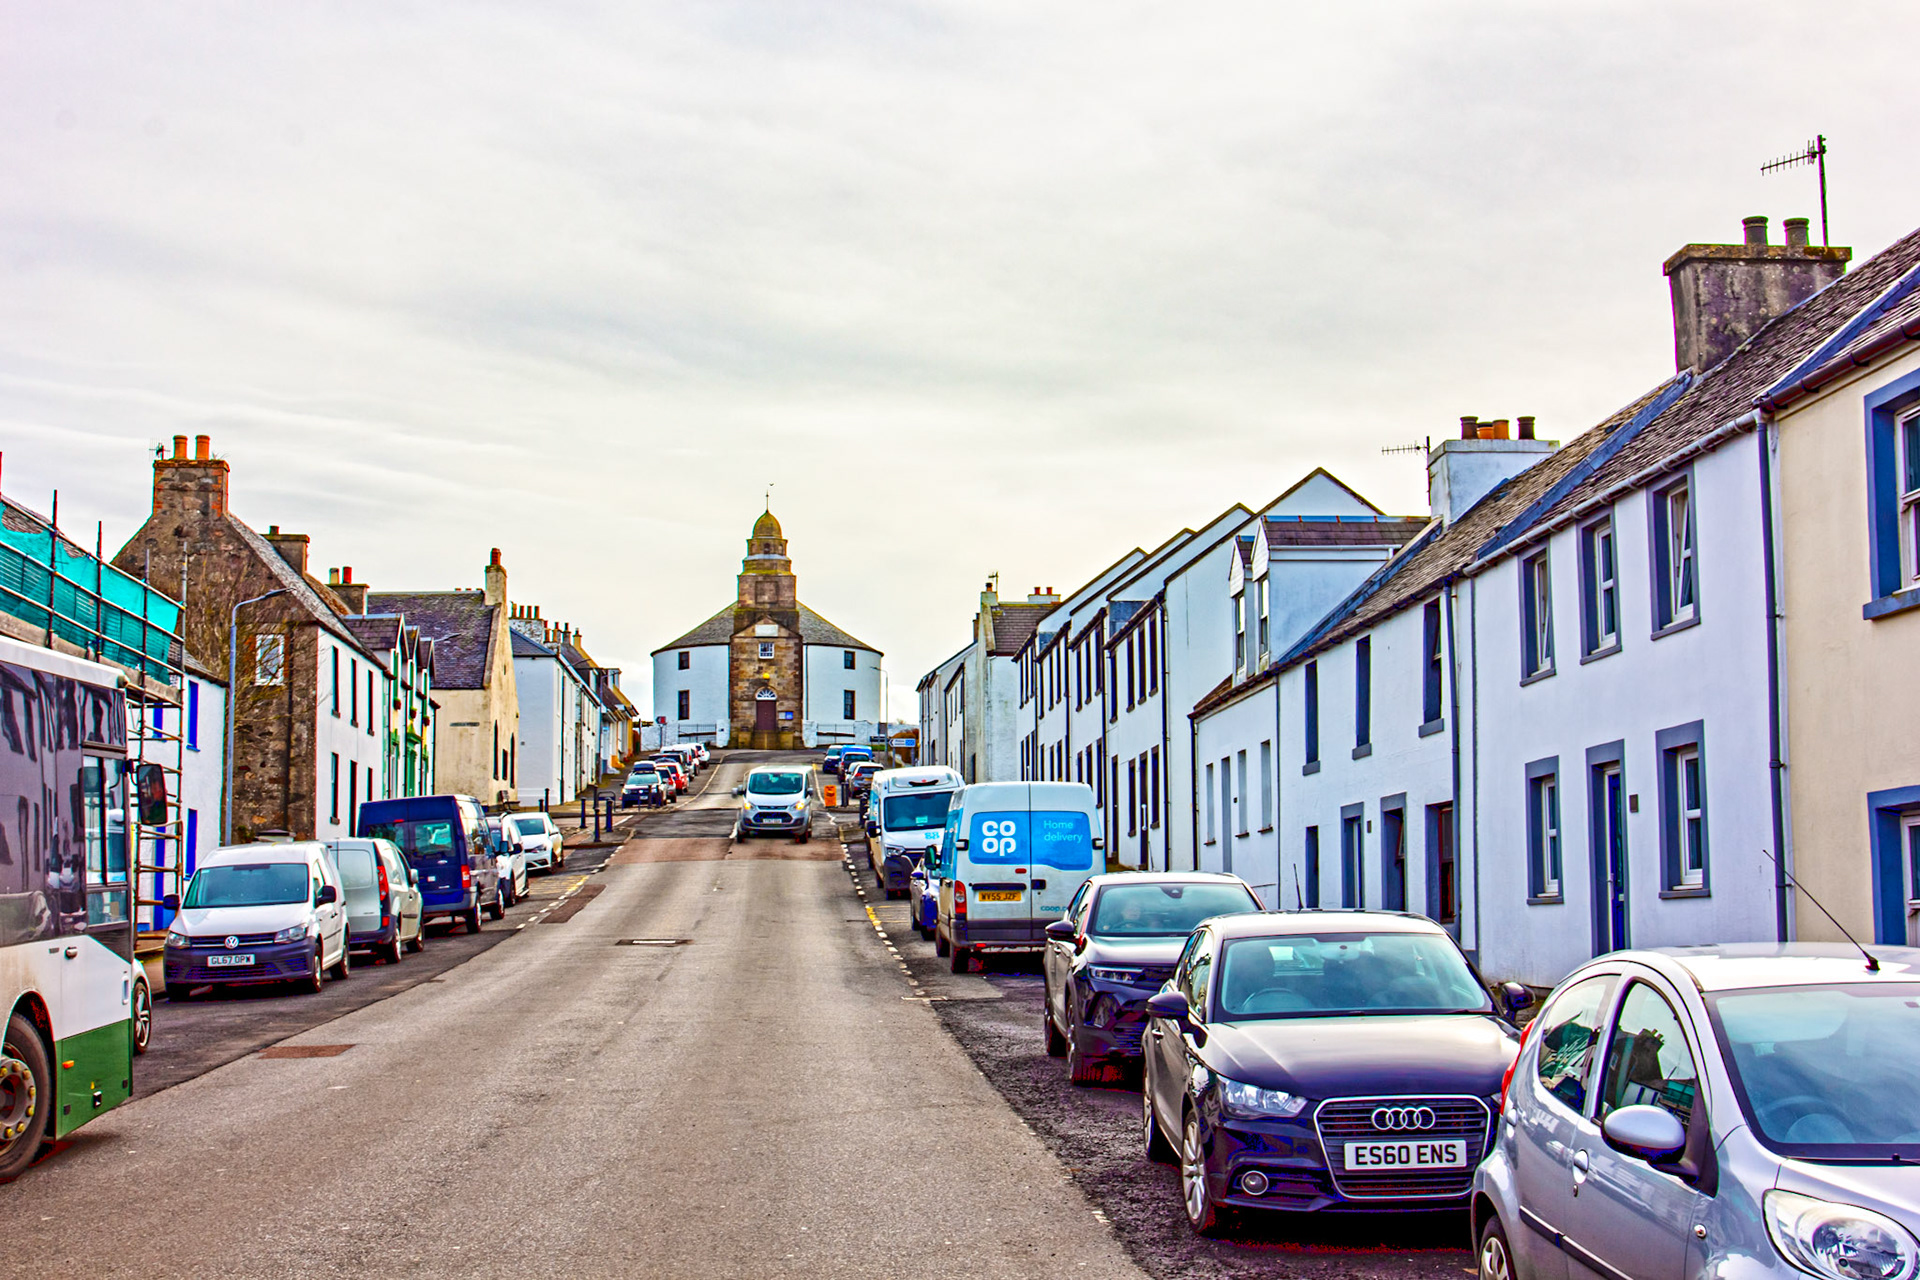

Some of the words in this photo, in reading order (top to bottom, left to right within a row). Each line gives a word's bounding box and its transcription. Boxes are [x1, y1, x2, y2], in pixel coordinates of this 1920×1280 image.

[1043, 820, 1074, 830] Home
[1044, 832, 1083, 844] delivery
[1040, 905, 1068, 913] coop.c
[1355, 1145, 1410, 1165] ES60
[1417, 1144, 1457, 1164] ENS
